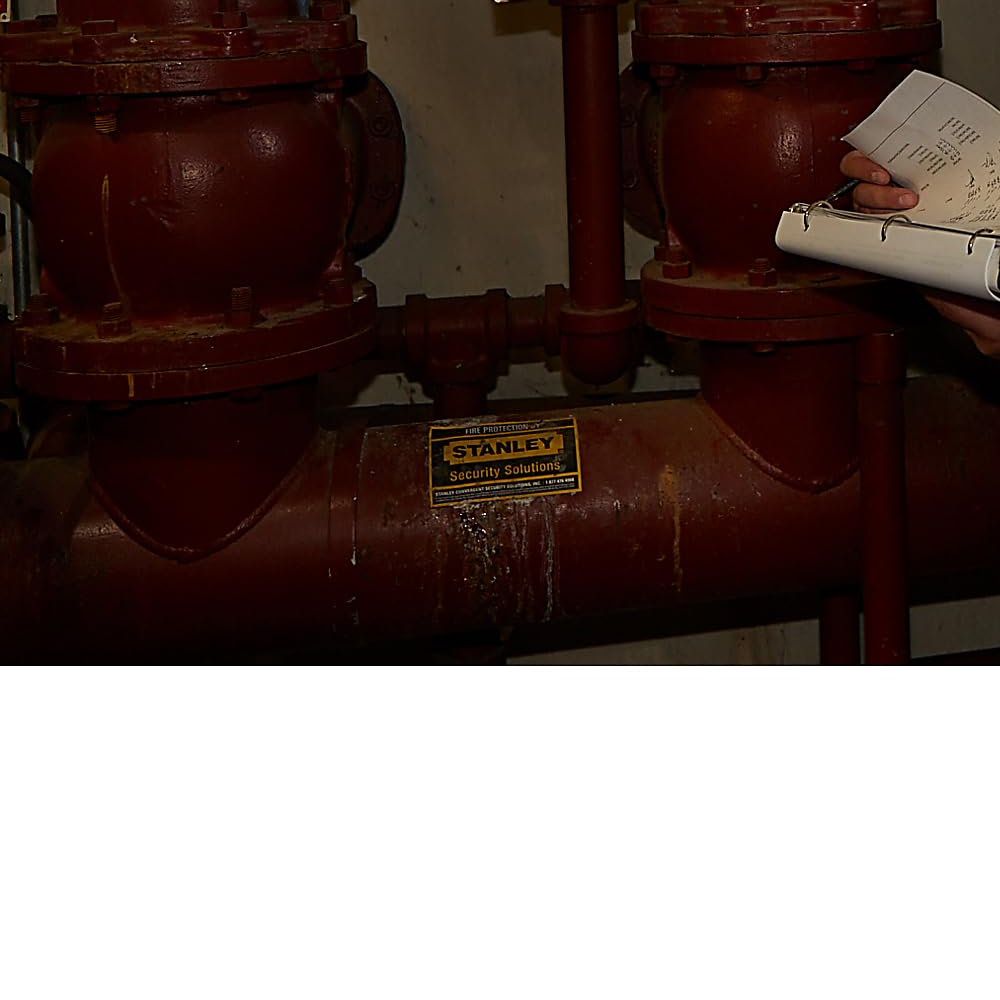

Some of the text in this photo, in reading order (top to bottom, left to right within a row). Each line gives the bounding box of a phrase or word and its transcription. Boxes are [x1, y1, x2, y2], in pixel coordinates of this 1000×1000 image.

[483, 424, 529, 433] PROTECTION
[452, 437, 554, 458] STANLEY
[450, 461, 561, 482] Security Solutions
